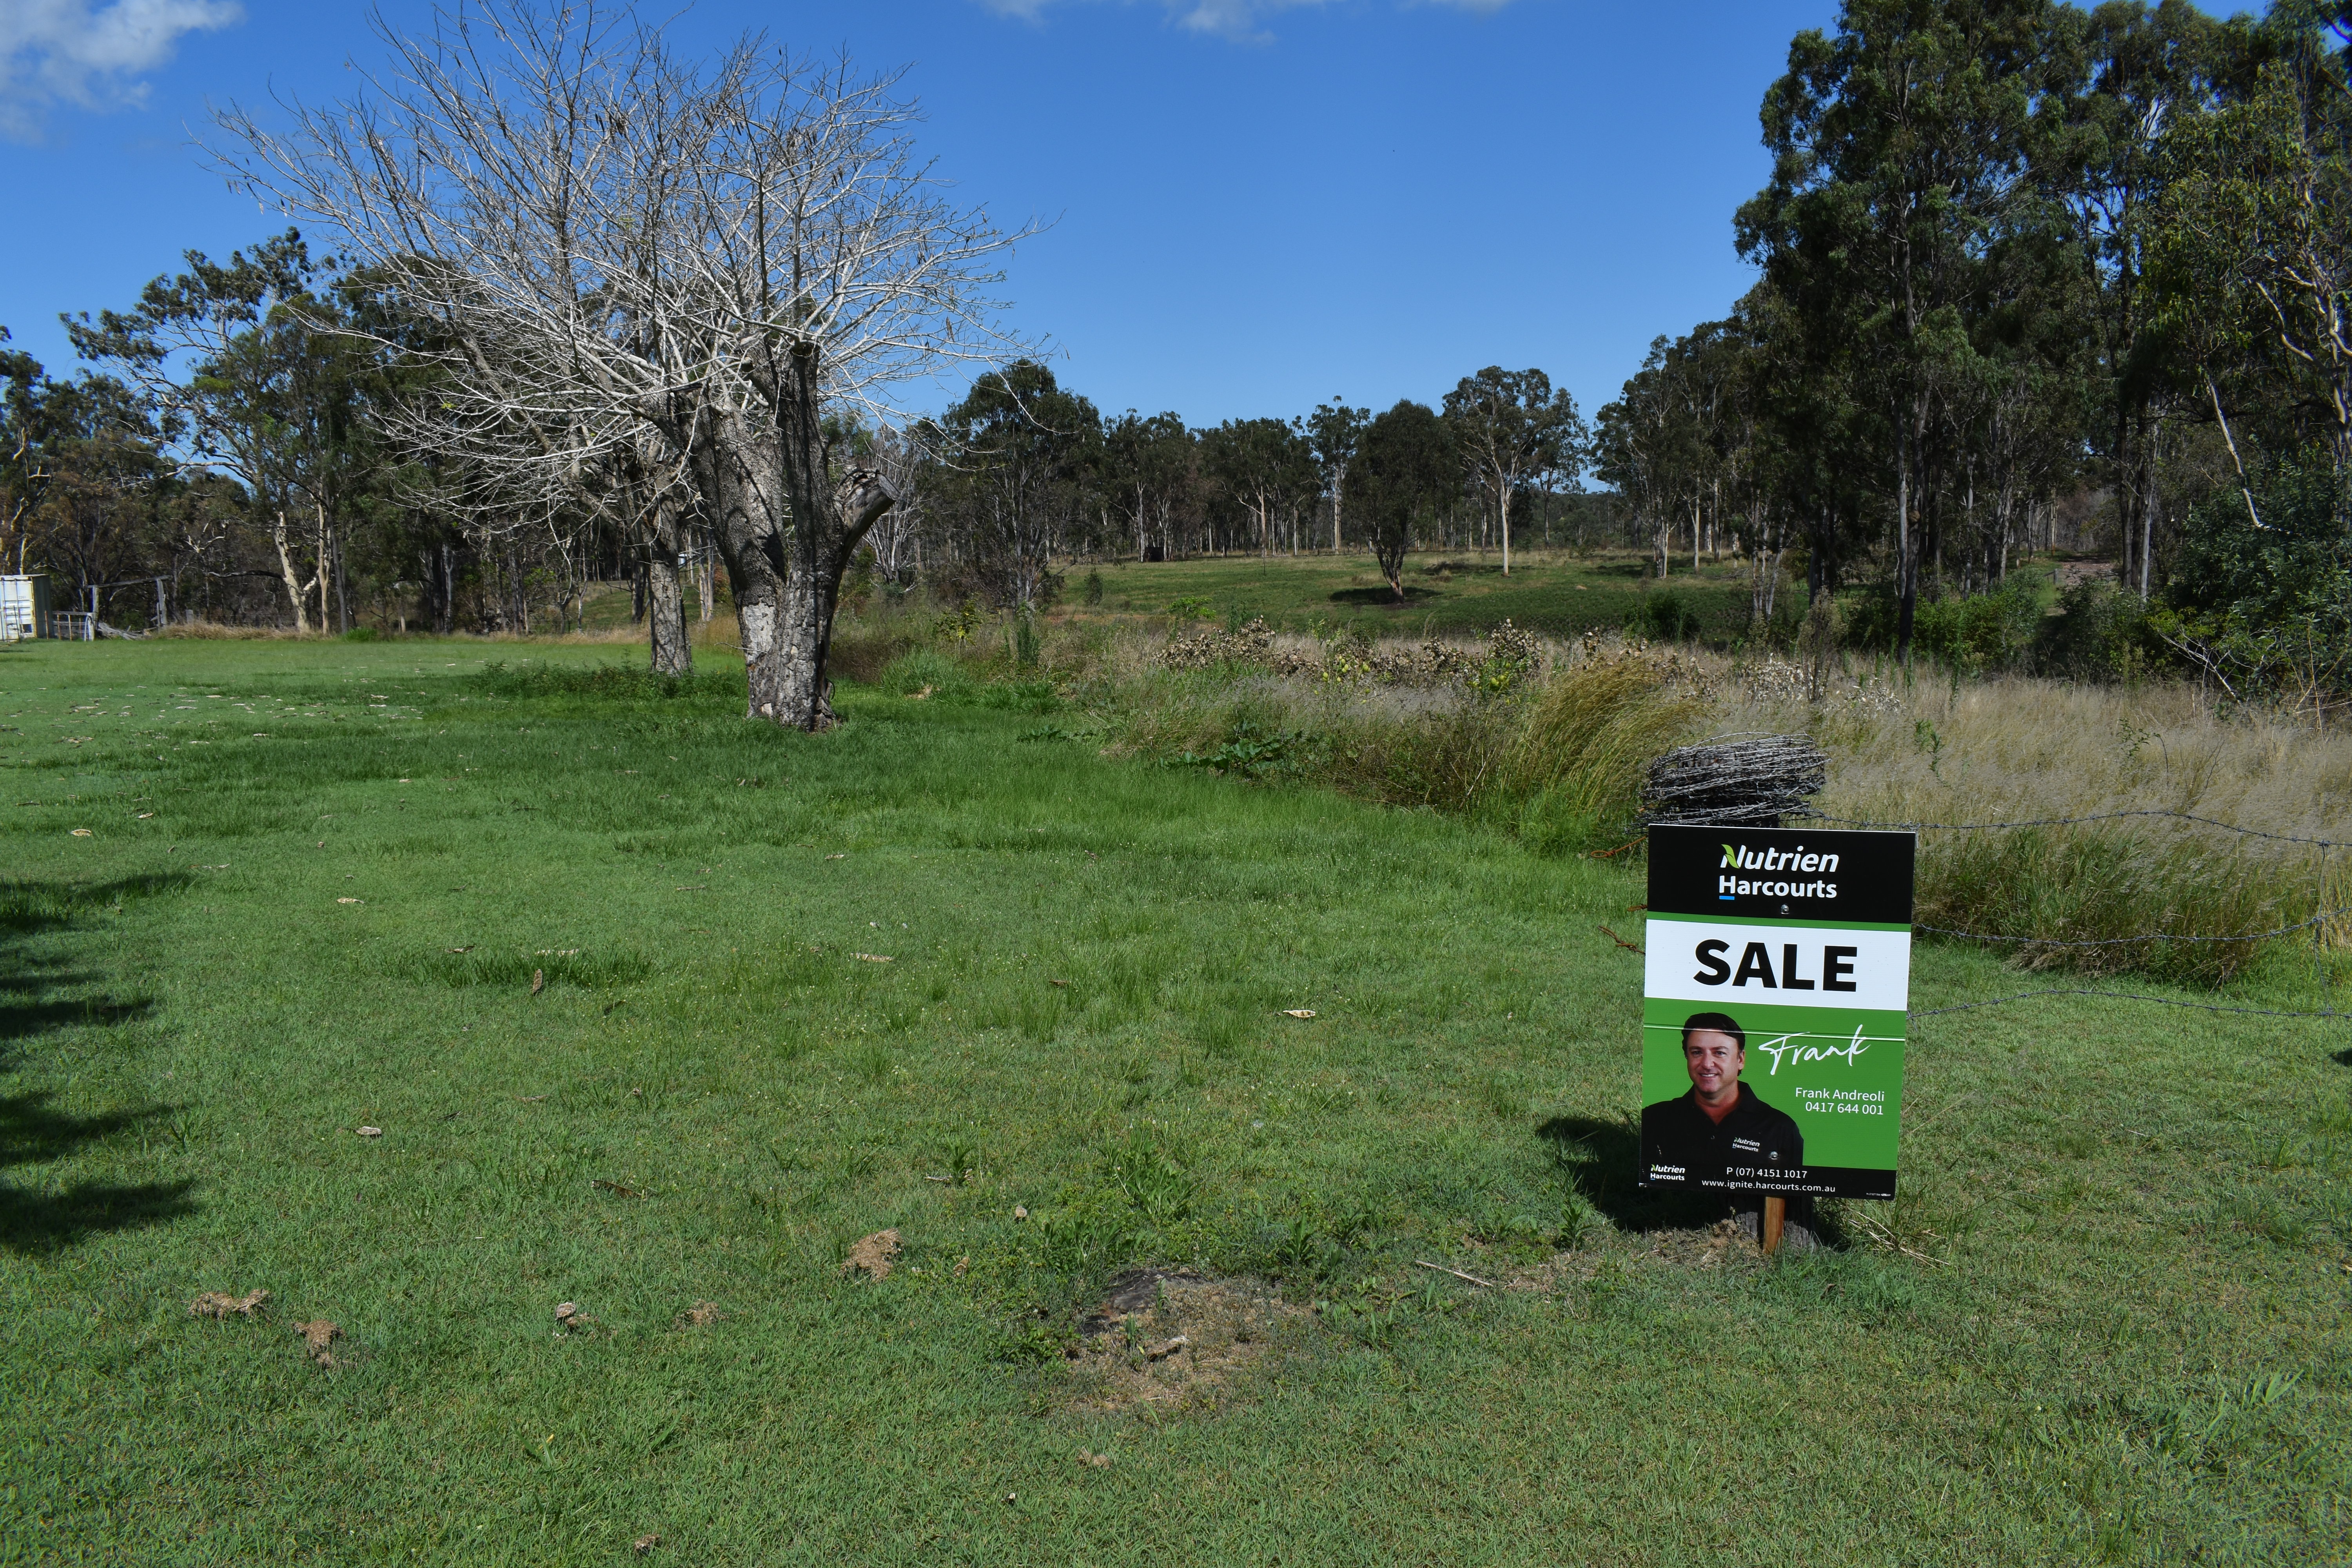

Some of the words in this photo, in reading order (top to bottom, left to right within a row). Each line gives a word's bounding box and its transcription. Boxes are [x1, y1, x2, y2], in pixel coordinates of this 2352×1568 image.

[1720, 844, 1839, 872] Nutrien
[1719, 875, 1837, 898] Harcourts
[1693, 939, 1857, 992] SALE
[1759, 1024, 1871, 1075] Frank
[1795, 1087, 1830, 1099] Frank
[1832, 1089, 1885, 1101] Andreoli
[1805, 1102, 1835, 1112] 0417
[1837, 1103, 1859, 1113] 644
[1862, 1105, 1884, 1115] 001
[1732, 1143, 1759, 1152] Harcourts
[1734, 1137, 1760, 1147] Nutrien
[1651, 1164, 1685, 1173] Nutrien
[1736, 1167, 1754, 1177] (07)
[1757, 1169, 1780, 1177] 4151
[1784, 1170, 1807, 1178] 1017
[1702, 1180, 1835, 1192] www.ignite.harcourts.com.au
